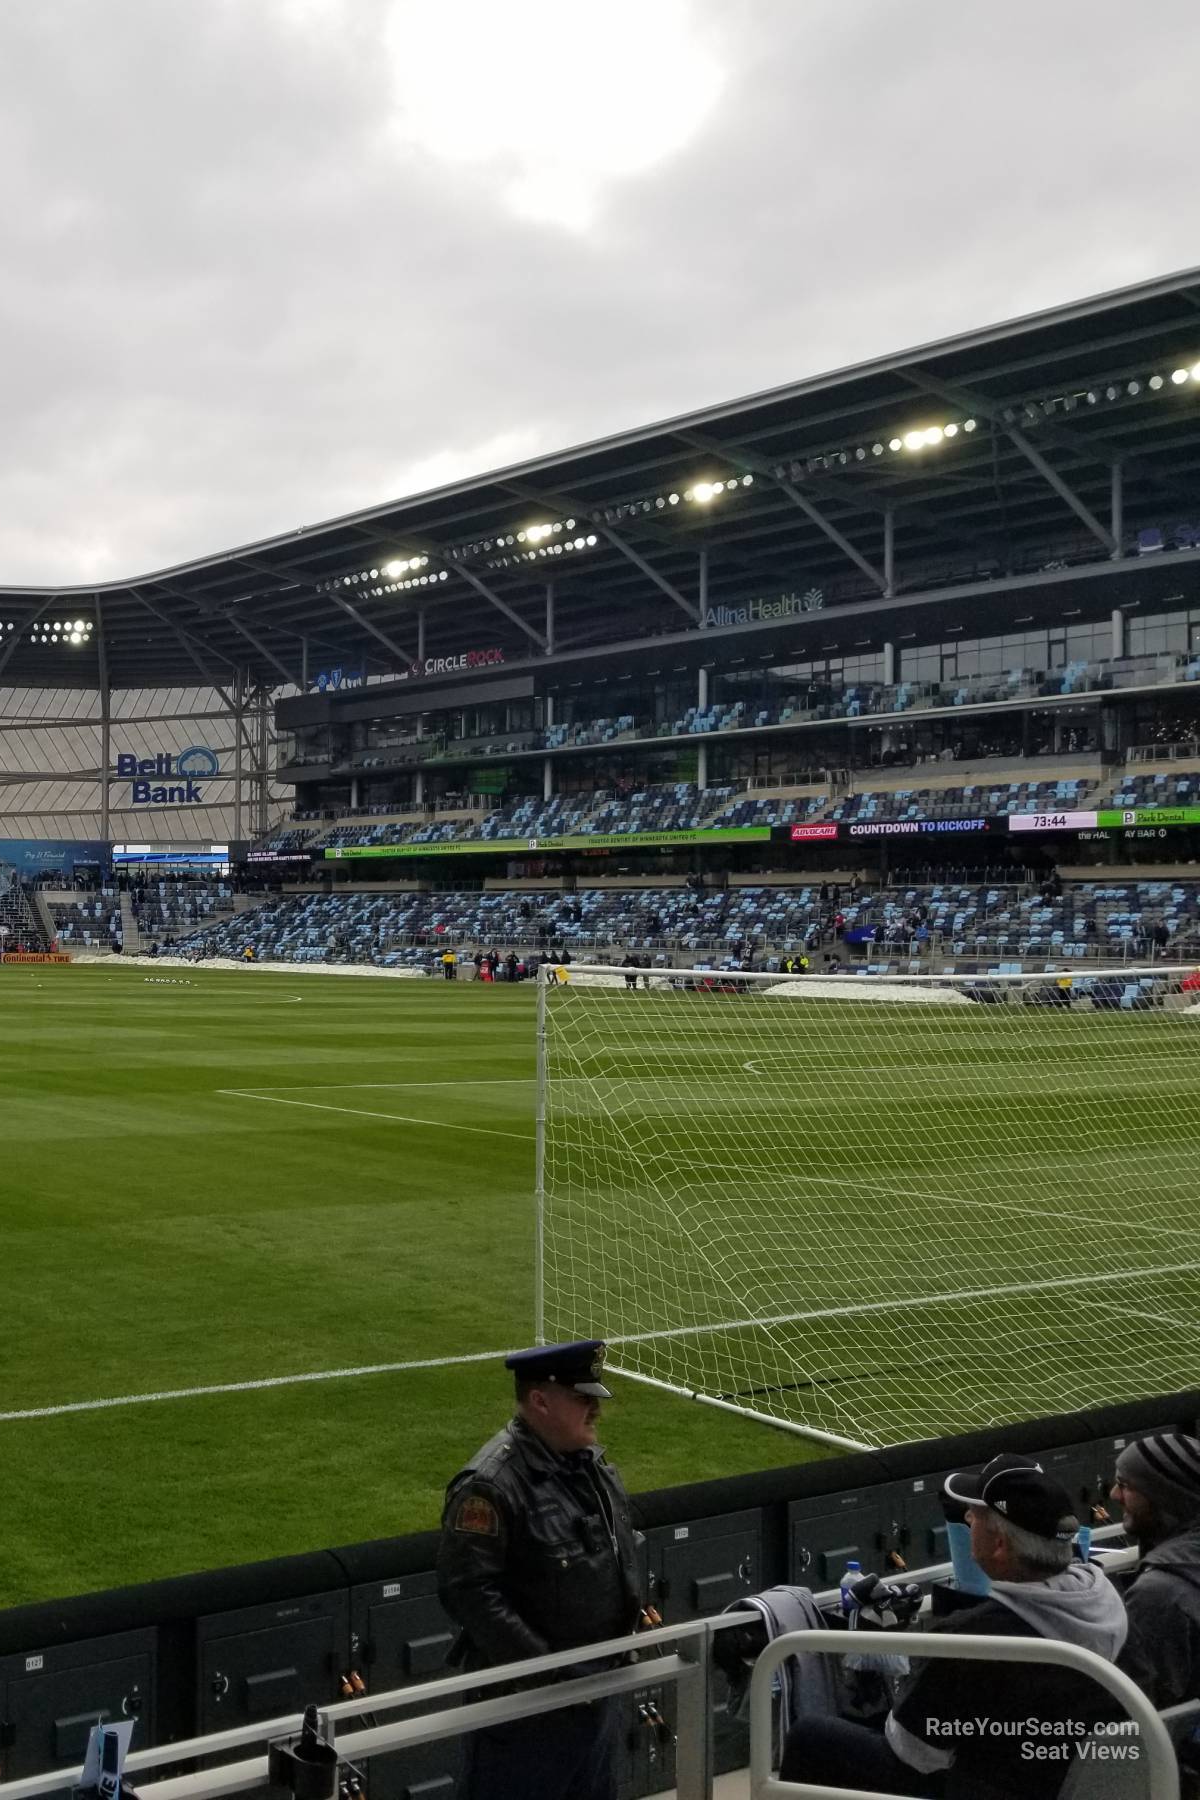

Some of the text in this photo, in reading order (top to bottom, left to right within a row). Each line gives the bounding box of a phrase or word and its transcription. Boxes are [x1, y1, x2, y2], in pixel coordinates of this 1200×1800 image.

[117, 752, 172, 777] Bell
[132, 780, 203, 803] Bank
[1033, 816, 1067, 827] 73:44
[1136, 813, 1157, 823] Park
[1157, 811, 1185, 822] Dental
[792, 827, 837, 837] ADVOCARE
[850, 822, 919, 835] COUNTDOWN
[920, 821, 936, 832] TO
[1137, 829, 1156, 839] BAR
[3, 953, 46, 963] Continental
